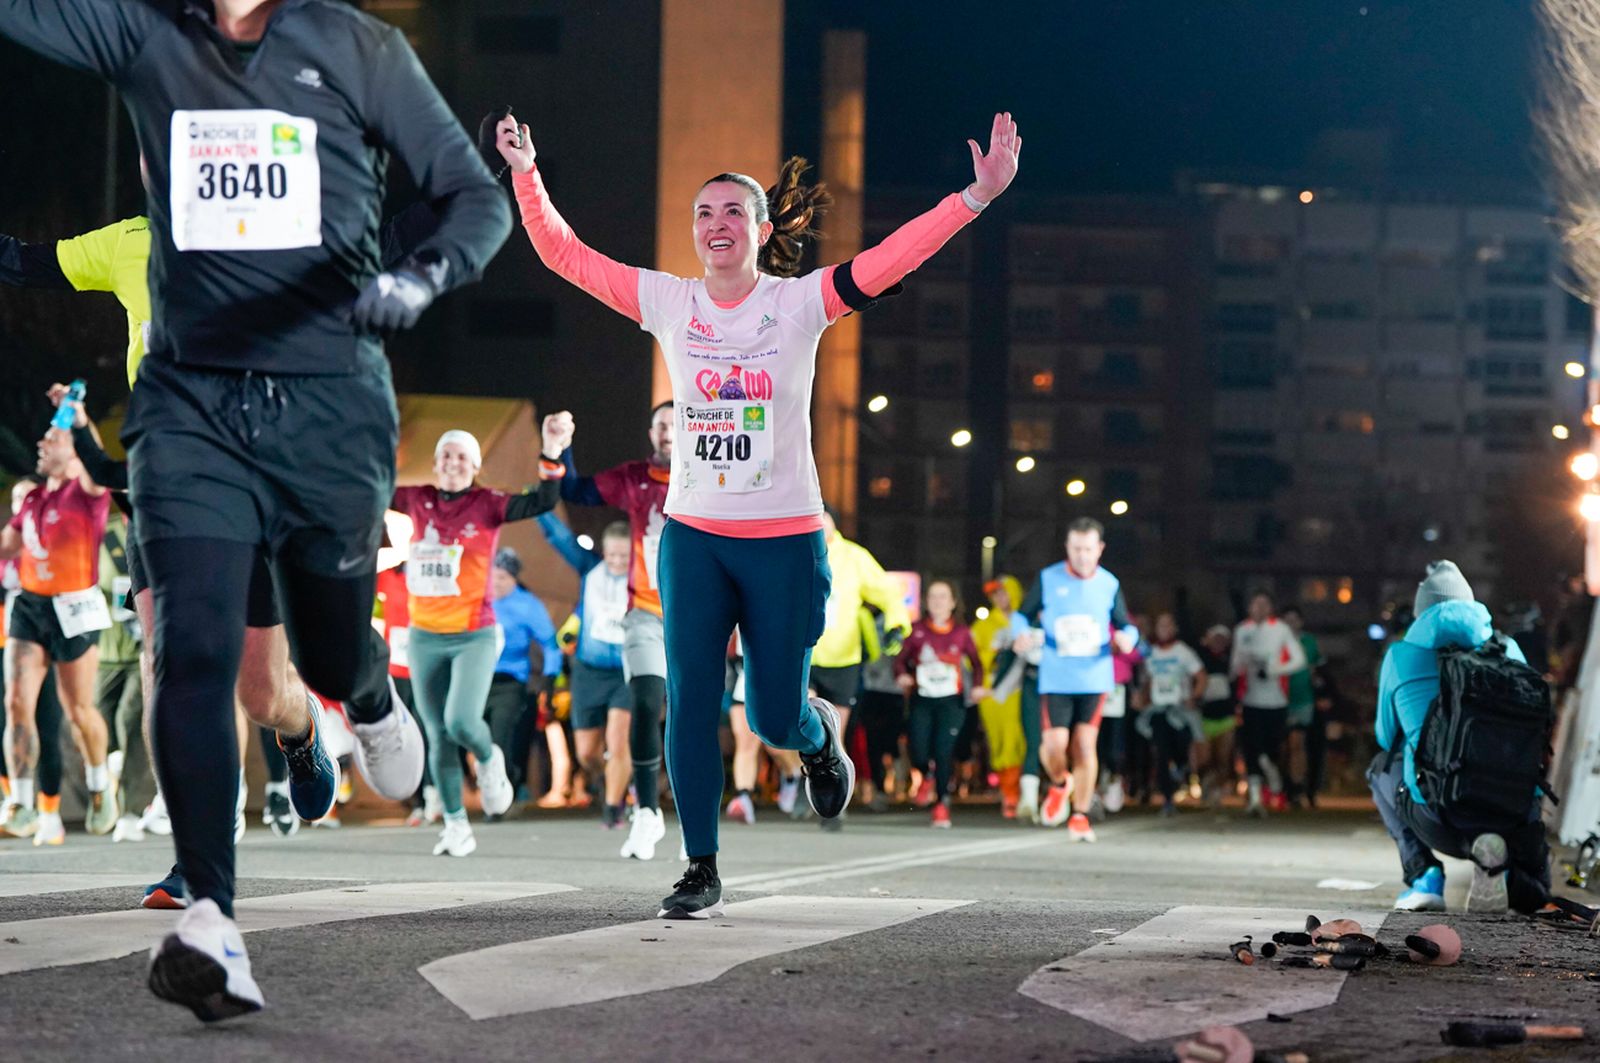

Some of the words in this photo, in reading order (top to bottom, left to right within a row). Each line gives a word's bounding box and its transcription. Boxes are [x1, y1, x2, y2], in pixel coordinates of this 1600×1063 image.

[198, 163, 287, 199] 3640
[687, 422, 705, 432] SAN
[706, 419, 735, 432] ANTÓN
[696, 411, 723, 421] NOCHE
[724, 411, 734, 420] DE
[695, 434, 751, 461] 4210
